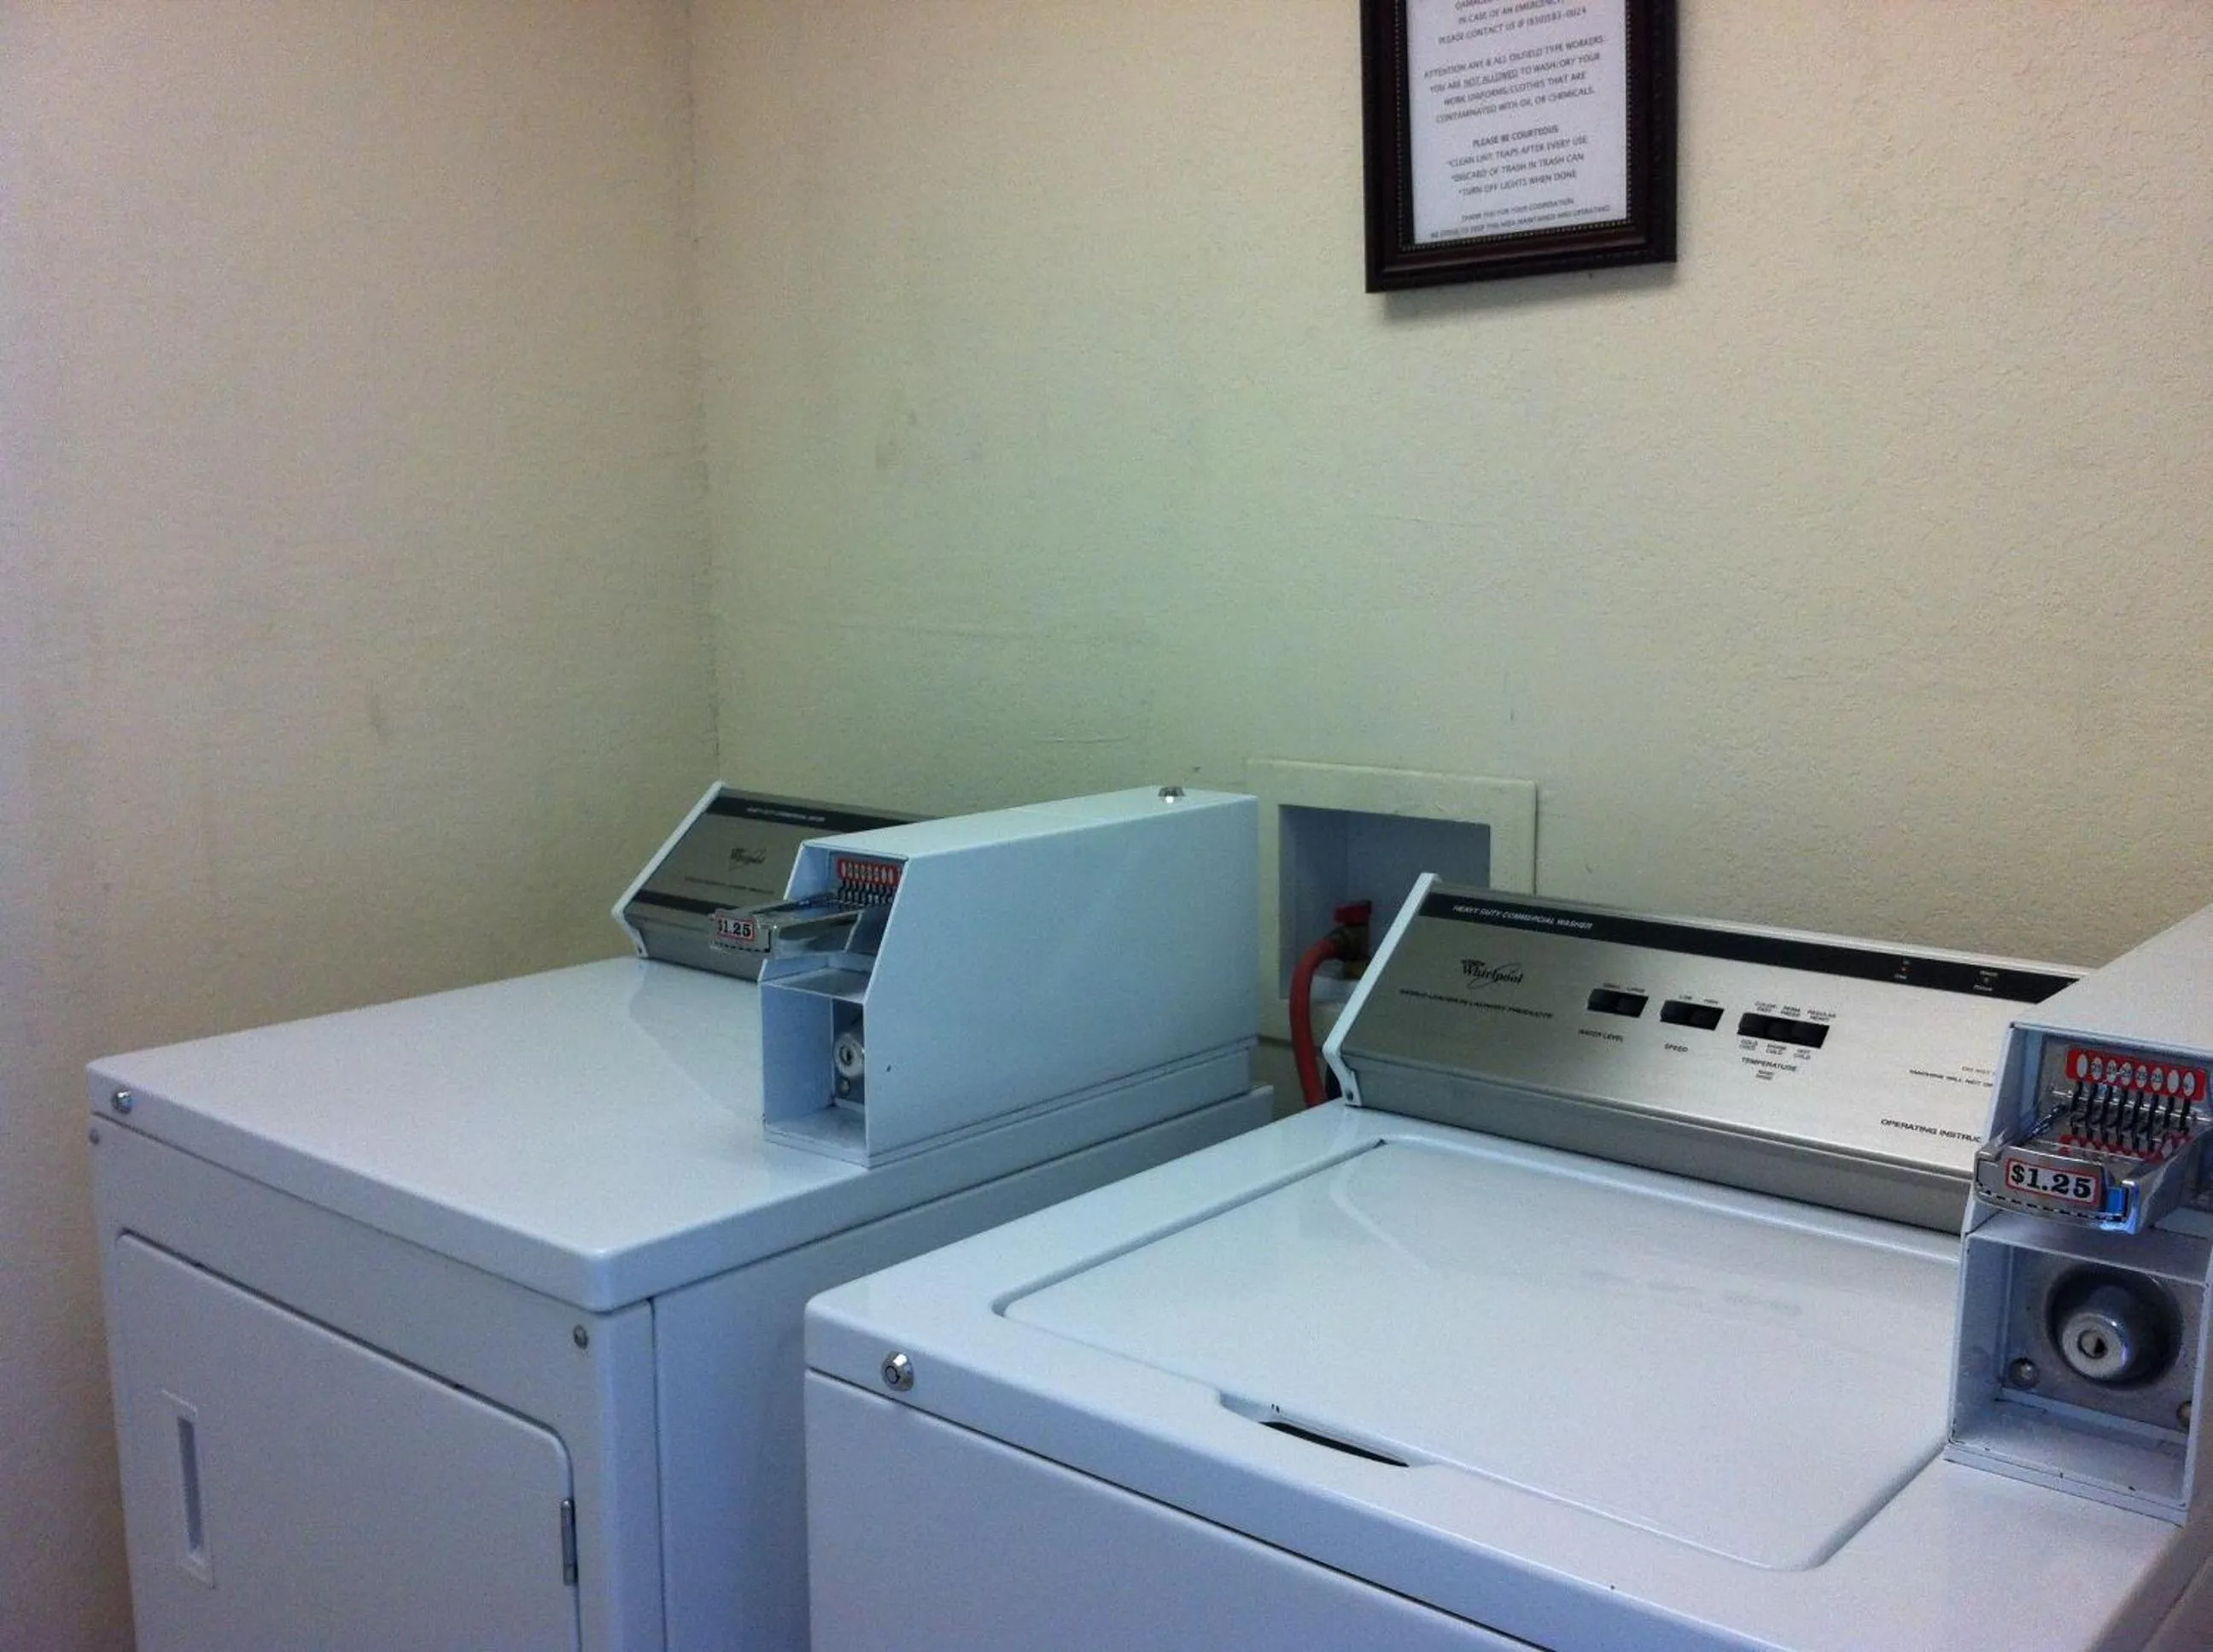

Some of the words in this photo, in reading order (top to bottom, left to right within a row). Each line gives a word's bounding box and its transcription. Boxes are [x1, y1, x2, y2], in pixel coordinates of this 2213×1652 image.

[1469, 12, 1487, 22] CASE
[1489, 9, 1500, 17] OF
[1438, 32, 1464, 44] PLEASE
[1466, 24, 1504, 38] CONTACT
[1469, 58, 1484, 69] ANY
[1493, 54, 1507, 65] ALL
[1545, 44, 1563, 55] TYPE
[1430, 83, 1445, 93] YOU
[1447, 79, 1462, 90] ARE
[1463, 75, 1481, 87] NOT
[1482, 69, 1518, 85] ALLOWED
[1521, 66, 1532, 75] TO
[1578, 52, 1600, 63] YOUR
[1444, 95, 1466, 106] WORK
[1548, 74, 1568, 85] THAT
[1571, 71, 1585, 80] ARE
[1435, 103, 1497, 124] CONTAMINATED
[1498, 101, 1518, 111] WITH
[1534, 95, 1546, 104] OR
[1473, 136, 1498, 147] PLEASE
[1501, 133, 1509, 143] BE
[1510, 125, 1559, 141] COURTEOUS
[1476, 153, 1493, 163] LINT
[1496, 148, 1519, 159] TRAPS
[1521, 143, 1544, 154] AFTER
[1546, 138, 1571, 150] EVERY
[1573, 134, 1588, 145] USE
[1488, 166, 1499, 177] OF
[1502, 163, 1527, 173] TRASH
[1528, 160, 1537, 169] IN
[1538, 155, 1564, 168] TRASH
[1566, 152, 1585, 163] CAN
[1484, 182, 1498, 193] OFF
[1500, 177, 1527, 189] LIGHTS
[1529, 173, 1552, 185] WHEN
[1553, 168, 1577, 180] DONE
[1452, 905, 1480, 914] HEAVY
[1480, 908, 1502, 918] DUTY
[1503, 911, 1555, 925] COMMERCIAL
[1556, 918, 1595, 930] WASHER
[1462, 962, 1524, 988] Whirlpool
[1603, 1032, 1623, 1042] LEVEL
[1664, 1042, 1689, 1053] SPEED
[1742, 1057, 1797, 1071] TEMPERATURE
[1880, 1118, 1937, 1135] OPERATING
[1939, 1128, 1982, 1144] INSTRUC
[2011, 1164, 2092, 1199] $1.25
